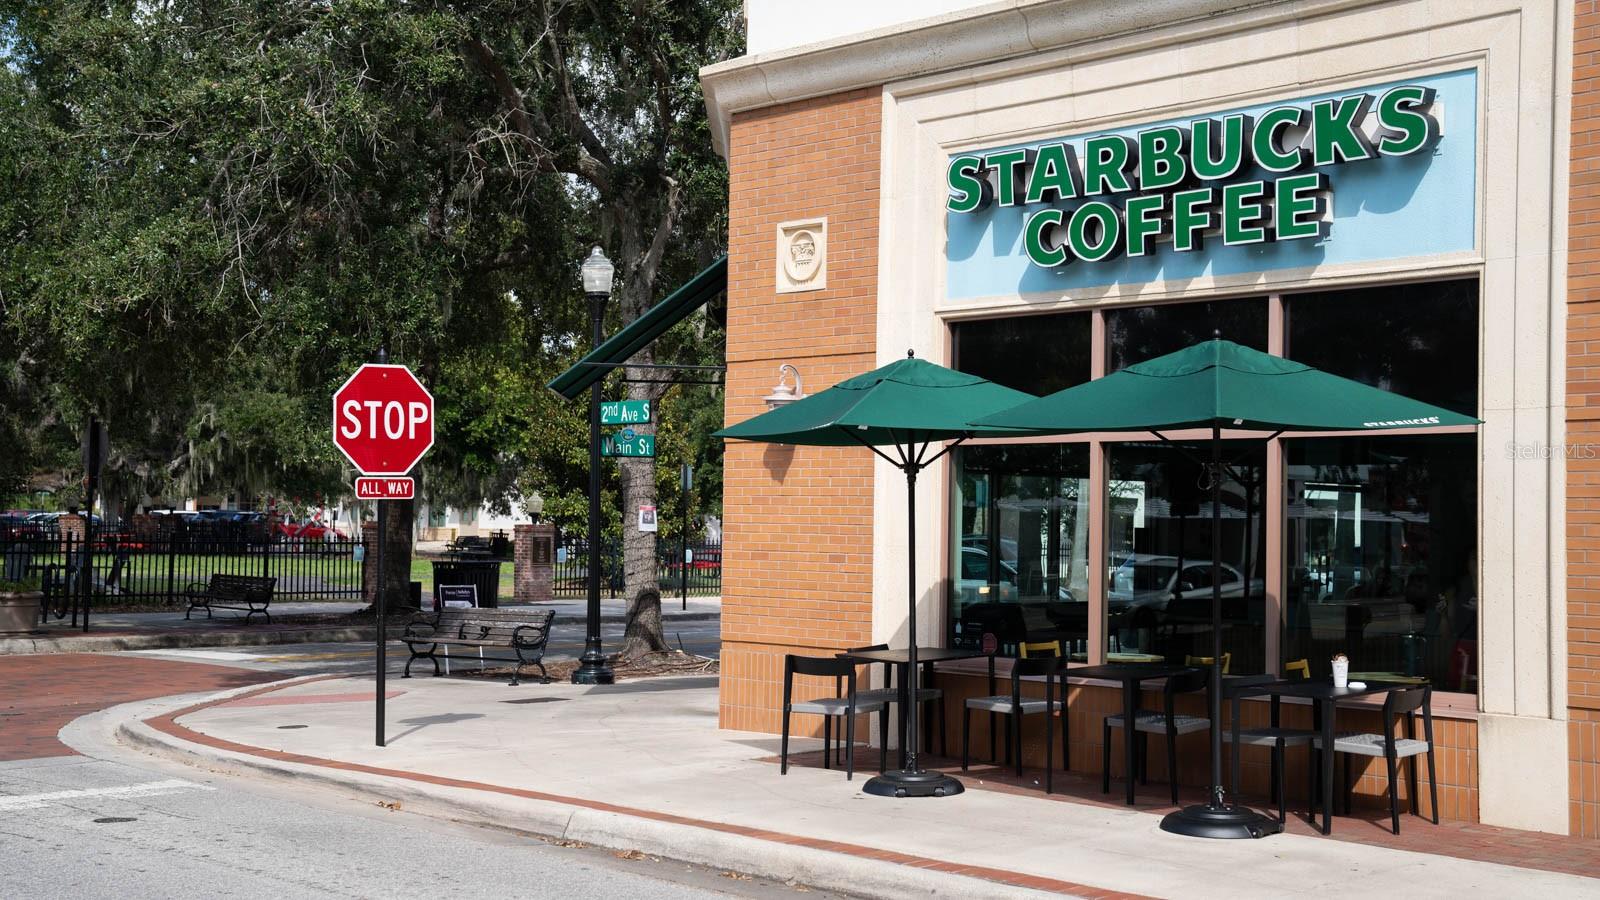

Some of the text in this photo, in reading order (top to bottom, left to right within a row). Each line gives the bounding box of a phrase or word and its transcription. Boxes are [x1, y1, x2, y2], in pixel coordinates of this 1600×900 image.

[945, 86, 1432, 214] STARBUCKS
[1023, 173, 1323, 268] COFFEE
[340, 399, 429, 440] STOP
[601, 402, 650, 423] 2nd Ave S
[605, 436, 650, 455] Main St
[361, 481, 410, 495] ALL WAY
